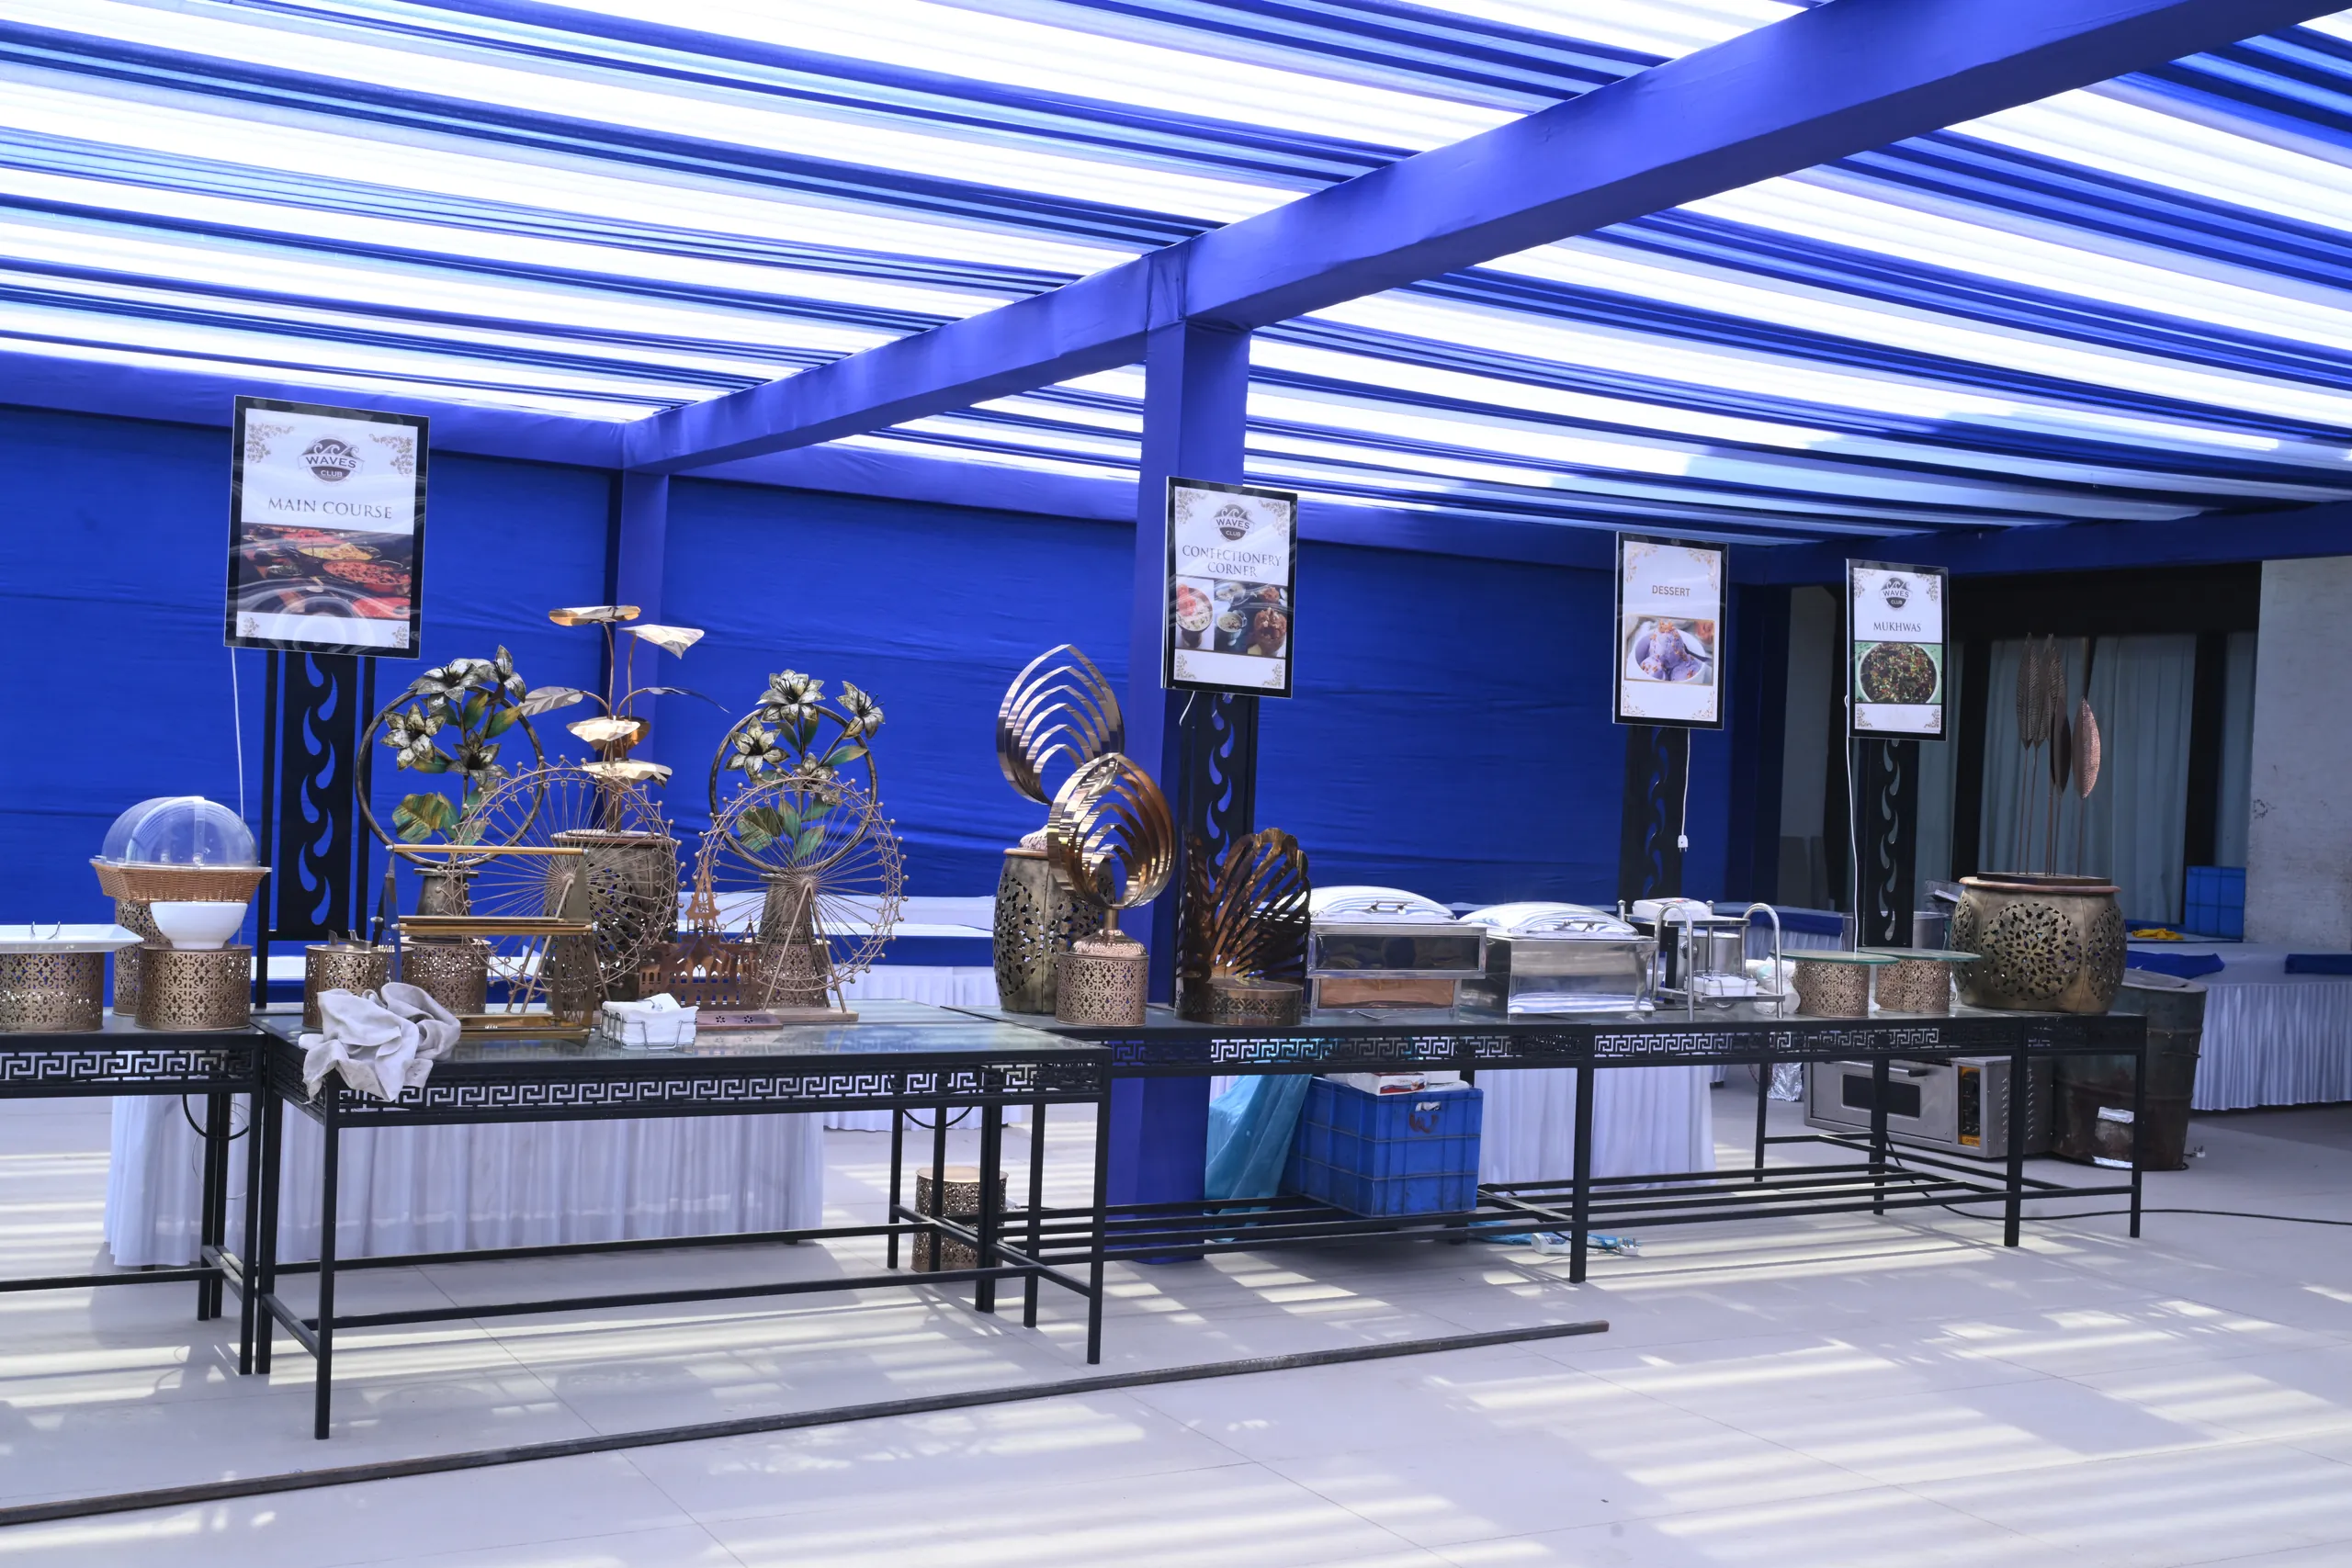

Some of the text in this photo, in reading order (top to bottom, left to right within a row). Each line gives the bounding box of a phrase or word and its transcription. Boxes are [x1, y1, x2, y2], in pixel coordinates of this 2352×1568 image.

[305, 456, 356, 469] WAVES
[320, 469, 343, 479] CLUB
[267, 497, 393, 520] MAIN COURSE
[1216, 518, 1250, 530] WAVES
[1182, 545, 1282, 567] CONFECTIONERY
[1207, 561, 1258, 578] CORNER
[1651, 584, 1691, 597] DESSERT
[1883, 590, 1910, 599] WAVES
[1872, 621, 1922, 633] MUKHWAS
